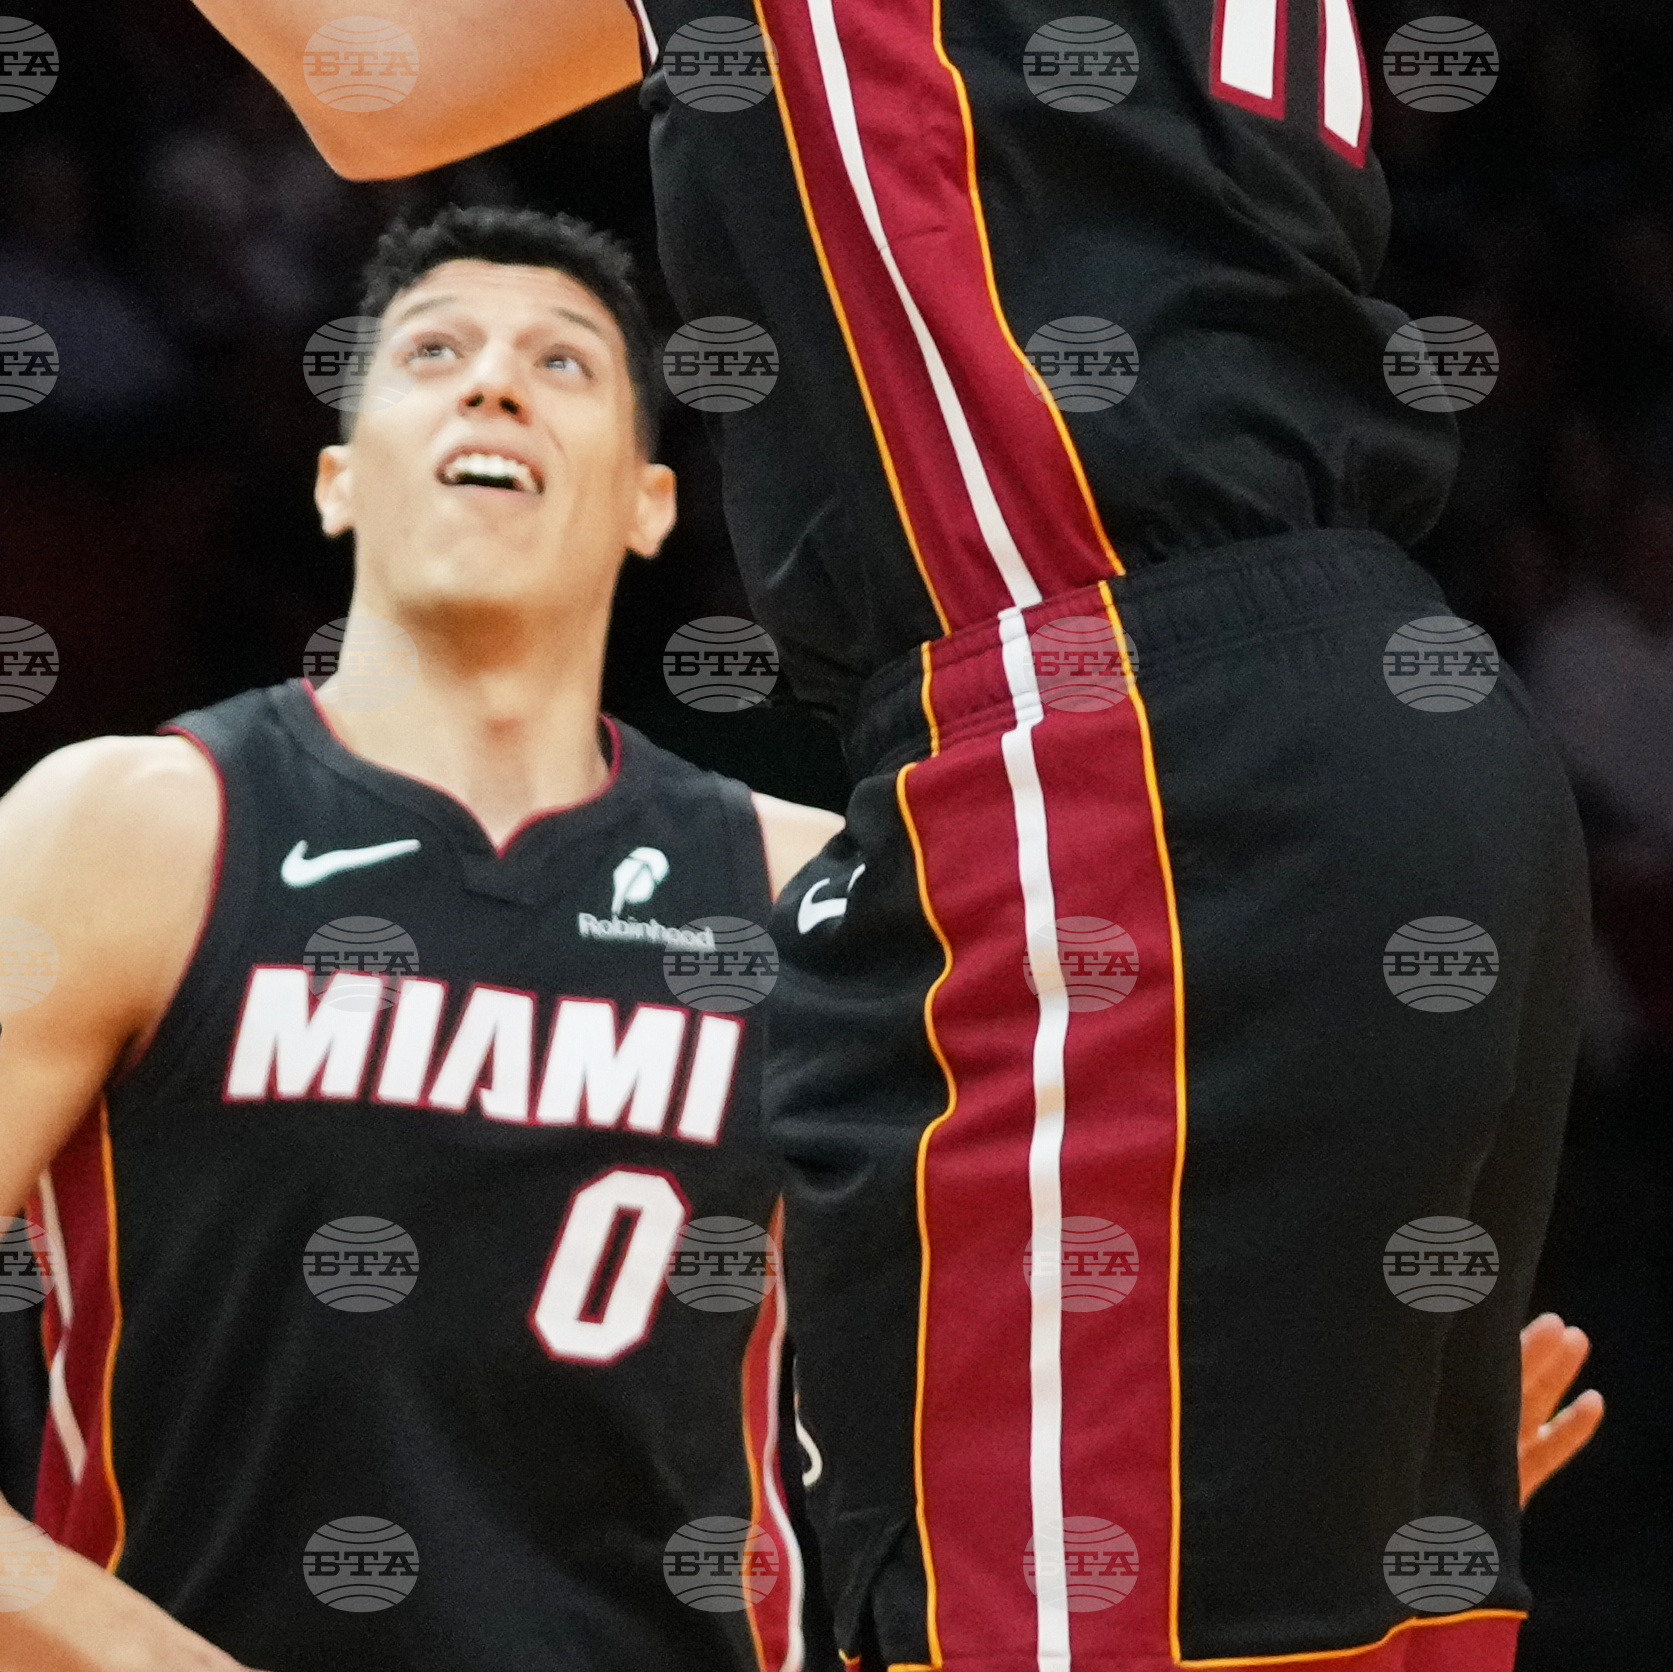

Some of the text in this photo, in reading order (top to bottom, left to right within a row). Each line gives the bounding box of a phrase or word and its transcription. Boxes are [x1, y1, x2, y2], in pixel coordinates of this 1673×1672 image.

[577, 911, 716, 952] Robinhood
[223, 963, 746, 1146] MIAMI
[529, 1164, 692, 1366] 0
